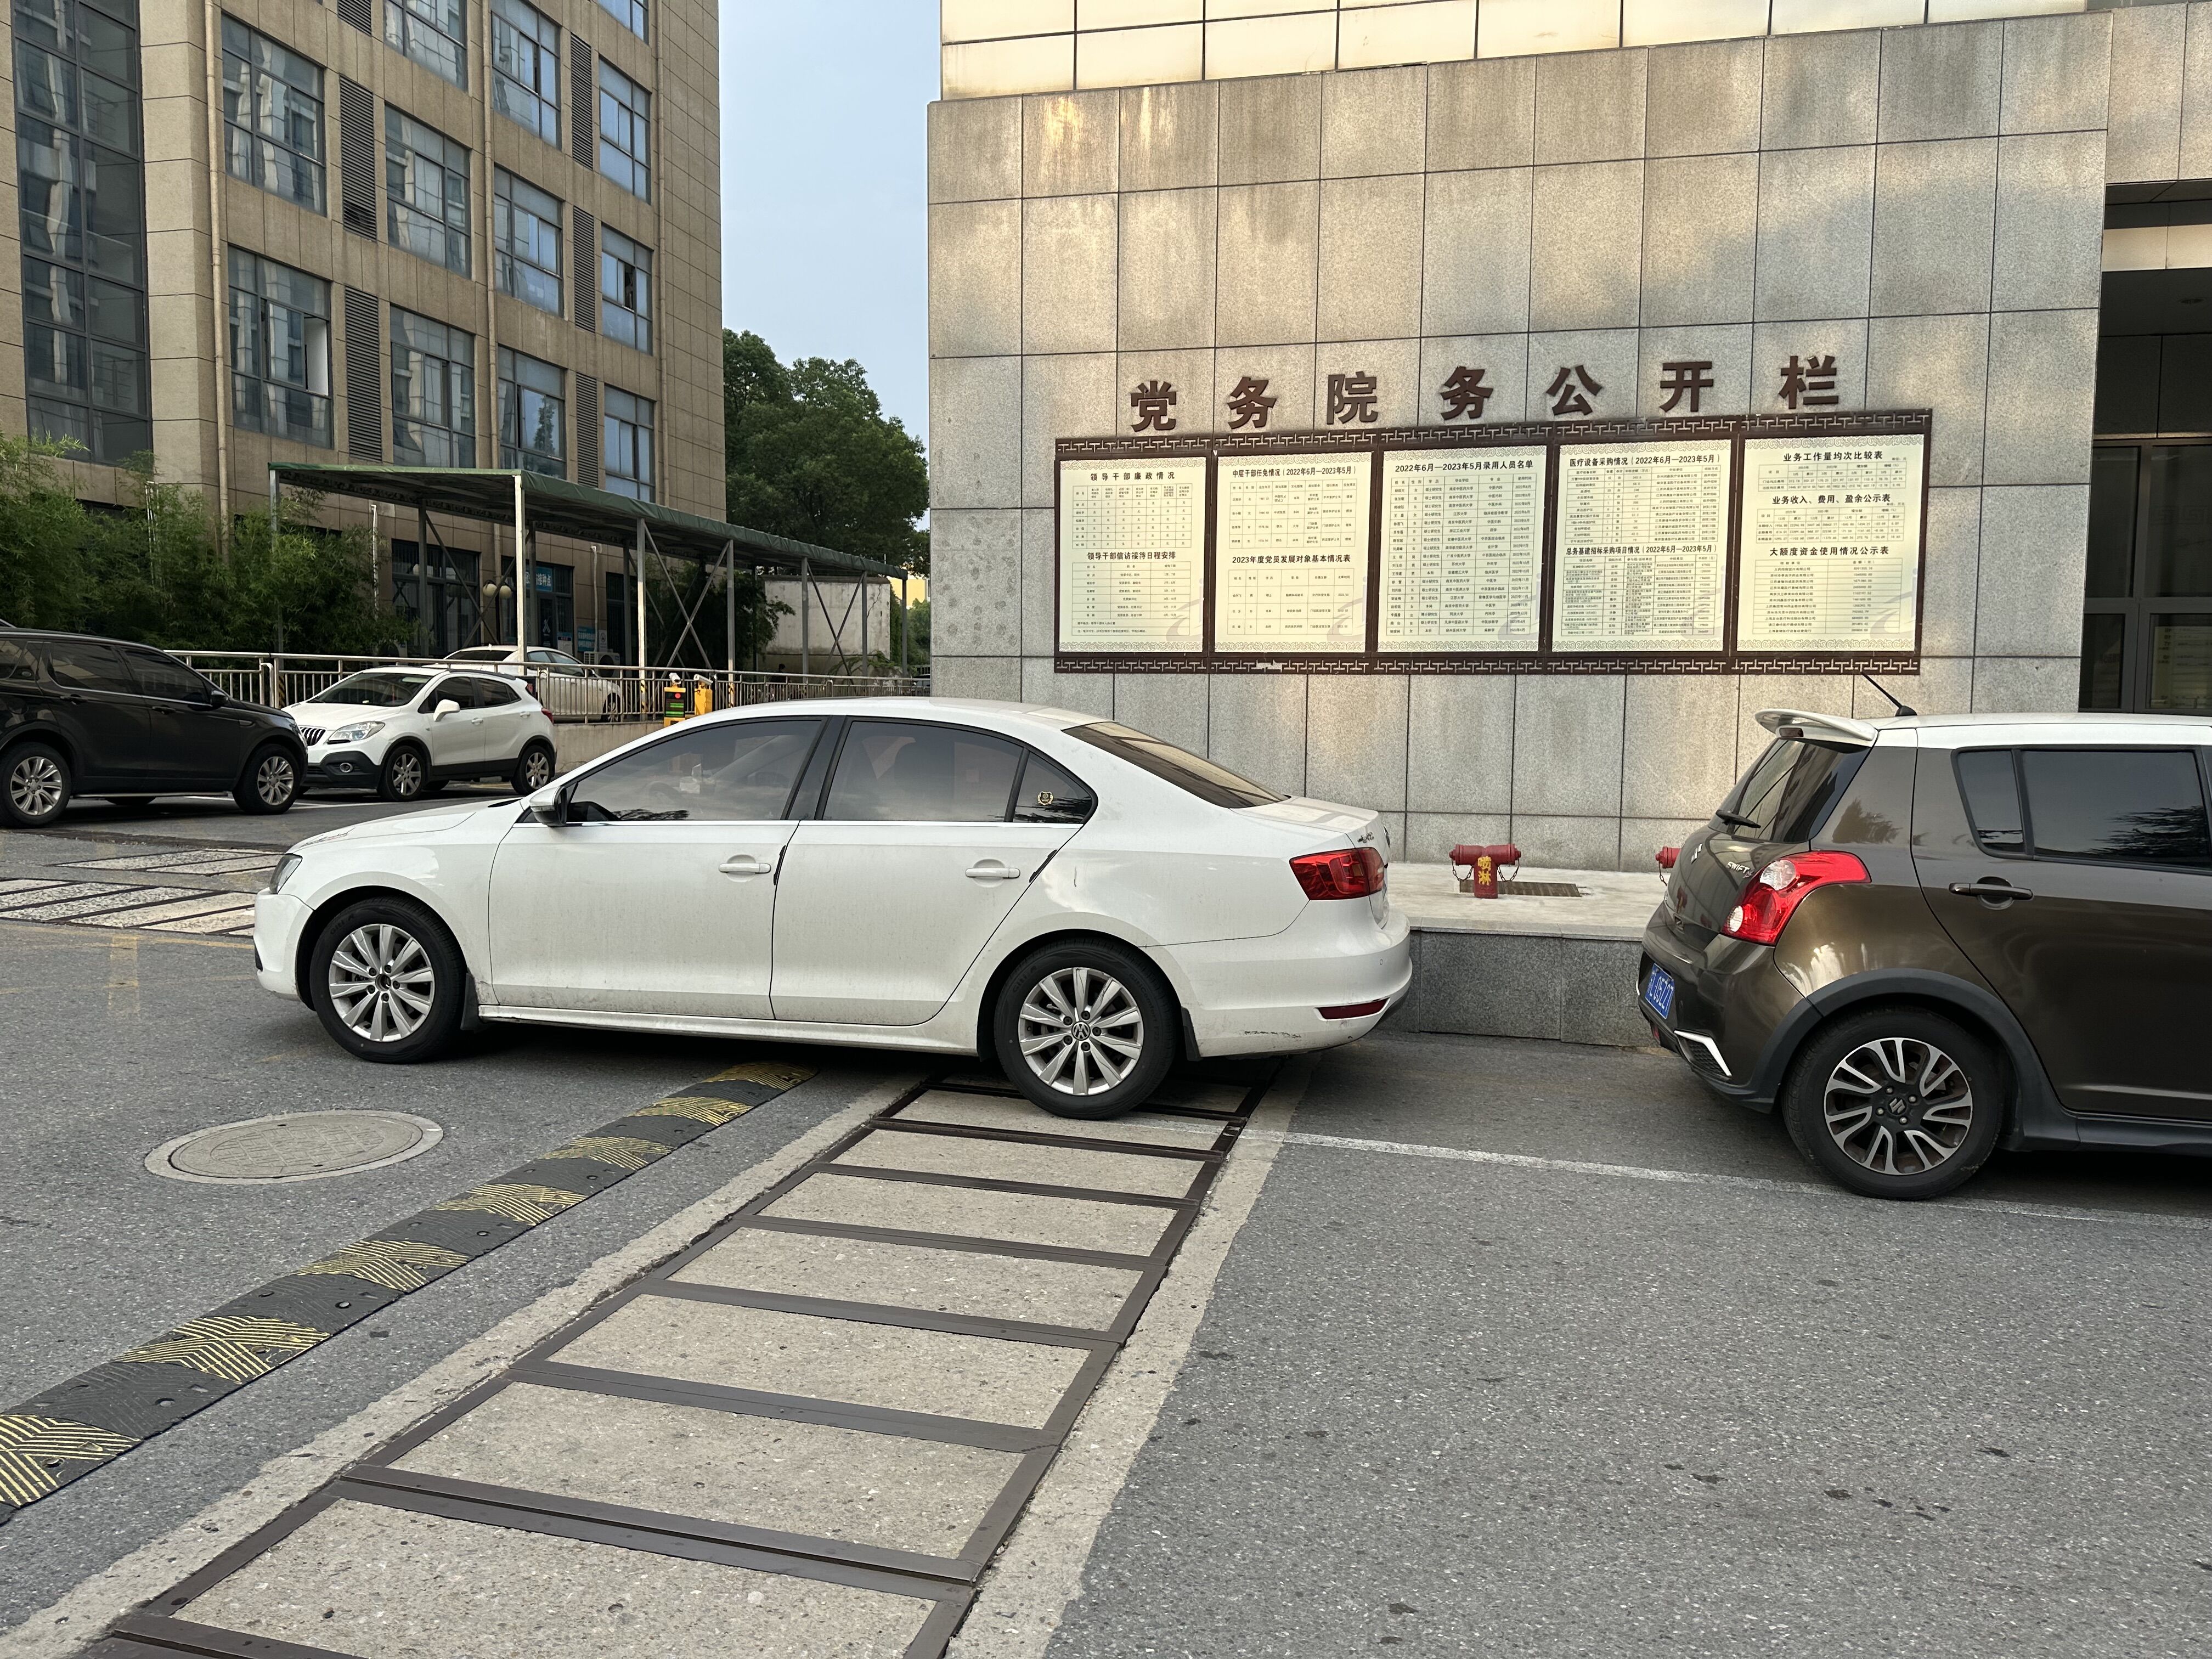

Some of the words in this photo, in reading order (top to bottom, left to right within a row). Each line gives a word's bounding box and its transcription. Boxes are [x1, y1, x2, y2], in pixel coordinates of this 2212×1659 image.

[1131, 355, 1839, 432] 党务院务公开栏
[1569, 454, 1719, 466] 医疗设备采购情况（2022年6月—2023年5月）
[1784, 451, 1882, 461] 业务工作量均次比较表
[1396, 460, 1533, 472] 2022年6月—2023年5月录用人员名单
[1091, 472, 1175, 481] 领导干部廉政情况
[1773, 494, 1890, 505] 业务收入、费用、盈余公示表
[1087, 551, 1175, 560] 领导干部信访接待日程安排
[1566, 544, 1716, 556] 总务基建招标采购项目情况（2022年6月—2023年5月）
[1770, 546, 1888, 556] 大额度资金使用情况公示表
[1233, 554, 1350, 563] 2023年度党员发展对象基本情况表
[1477, 855, 1494, 886] 喷淋
[1726, 861, 1751, 873] SWIFT
